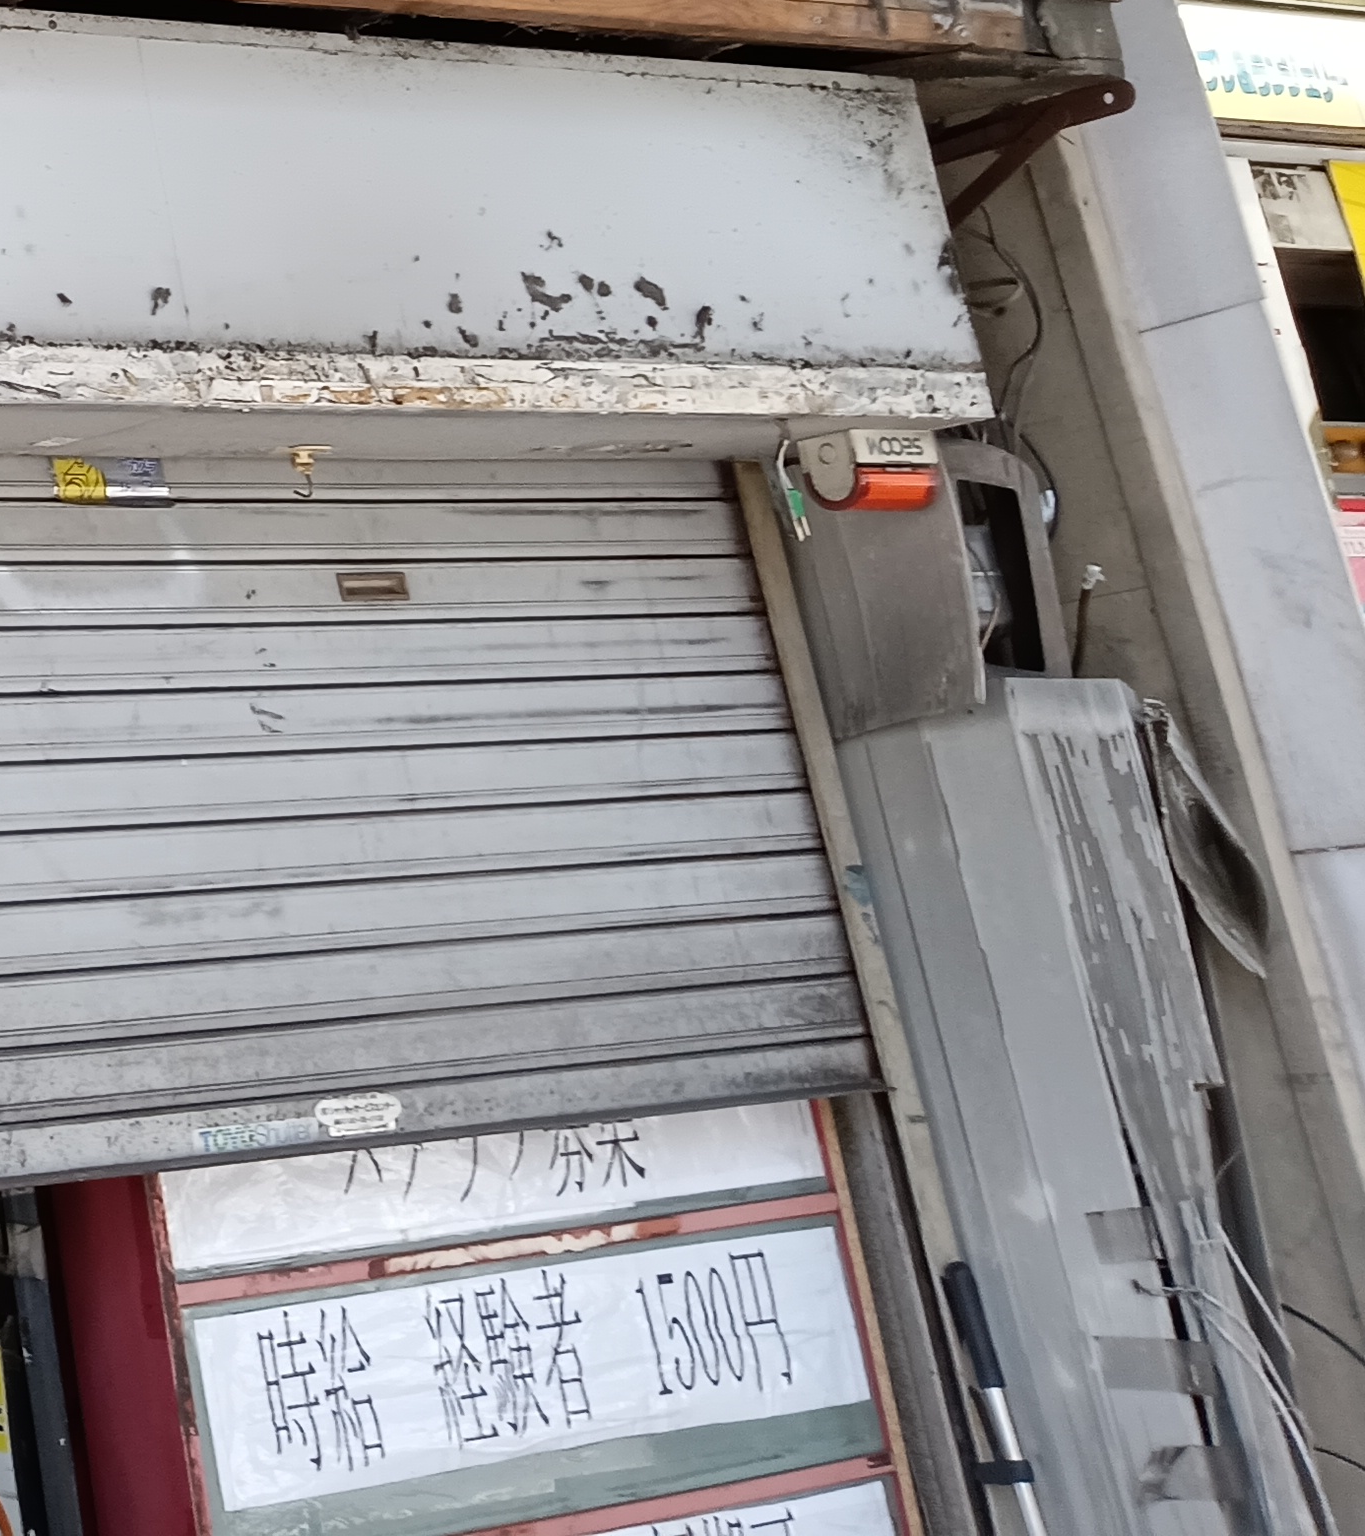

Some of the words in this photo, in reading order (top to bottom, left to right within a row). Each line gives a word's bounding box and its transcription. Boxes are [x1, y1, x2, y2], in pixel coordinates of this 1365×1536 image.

[256, 1306, 385, 1471] 時給
[424, 1269, 592, 1450] 経験者
[636, 1250, 793, 1397] 1500円
